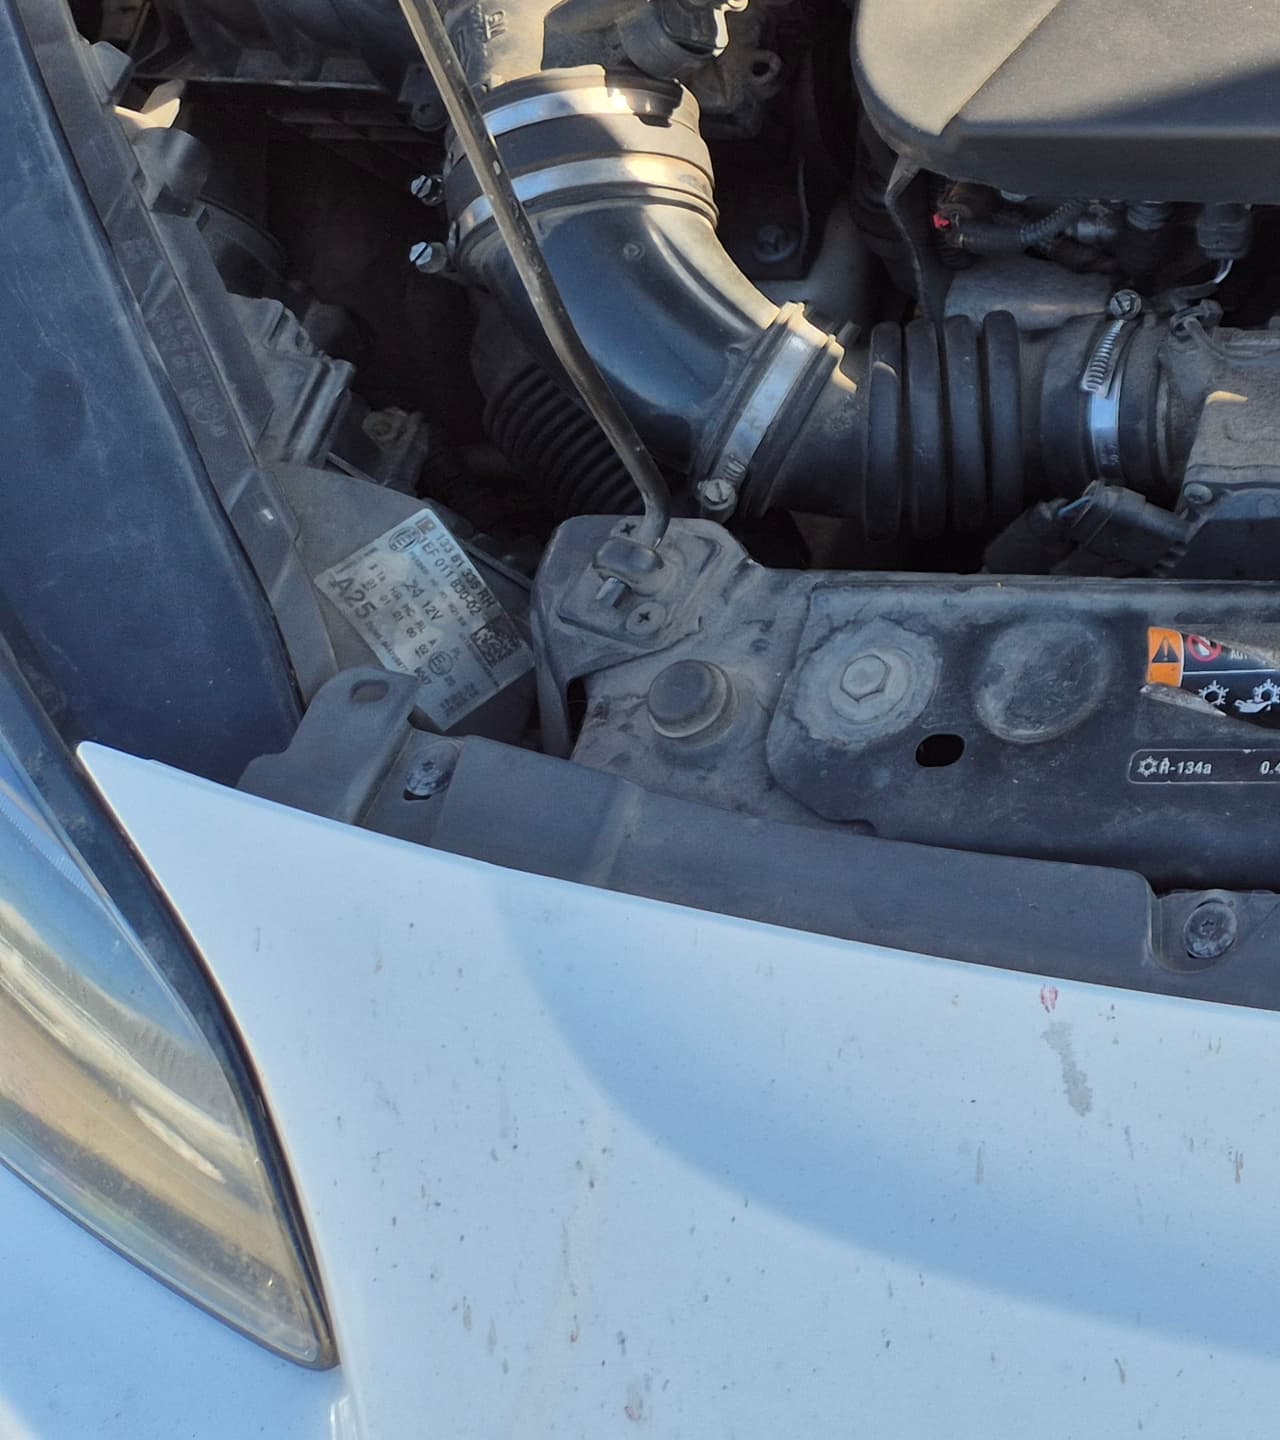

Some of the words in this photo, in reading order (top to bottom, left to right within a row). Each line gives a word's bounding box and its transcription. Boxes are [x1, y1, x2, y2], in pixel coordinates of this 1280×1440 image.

[433, 556, 454, 579] 011
[330, 572, 377, 621] A25
[476, 587, 495, 608] RH
[420, 598, 443, 622] 12V
[1159, 759, 1212, 775] R-134a
